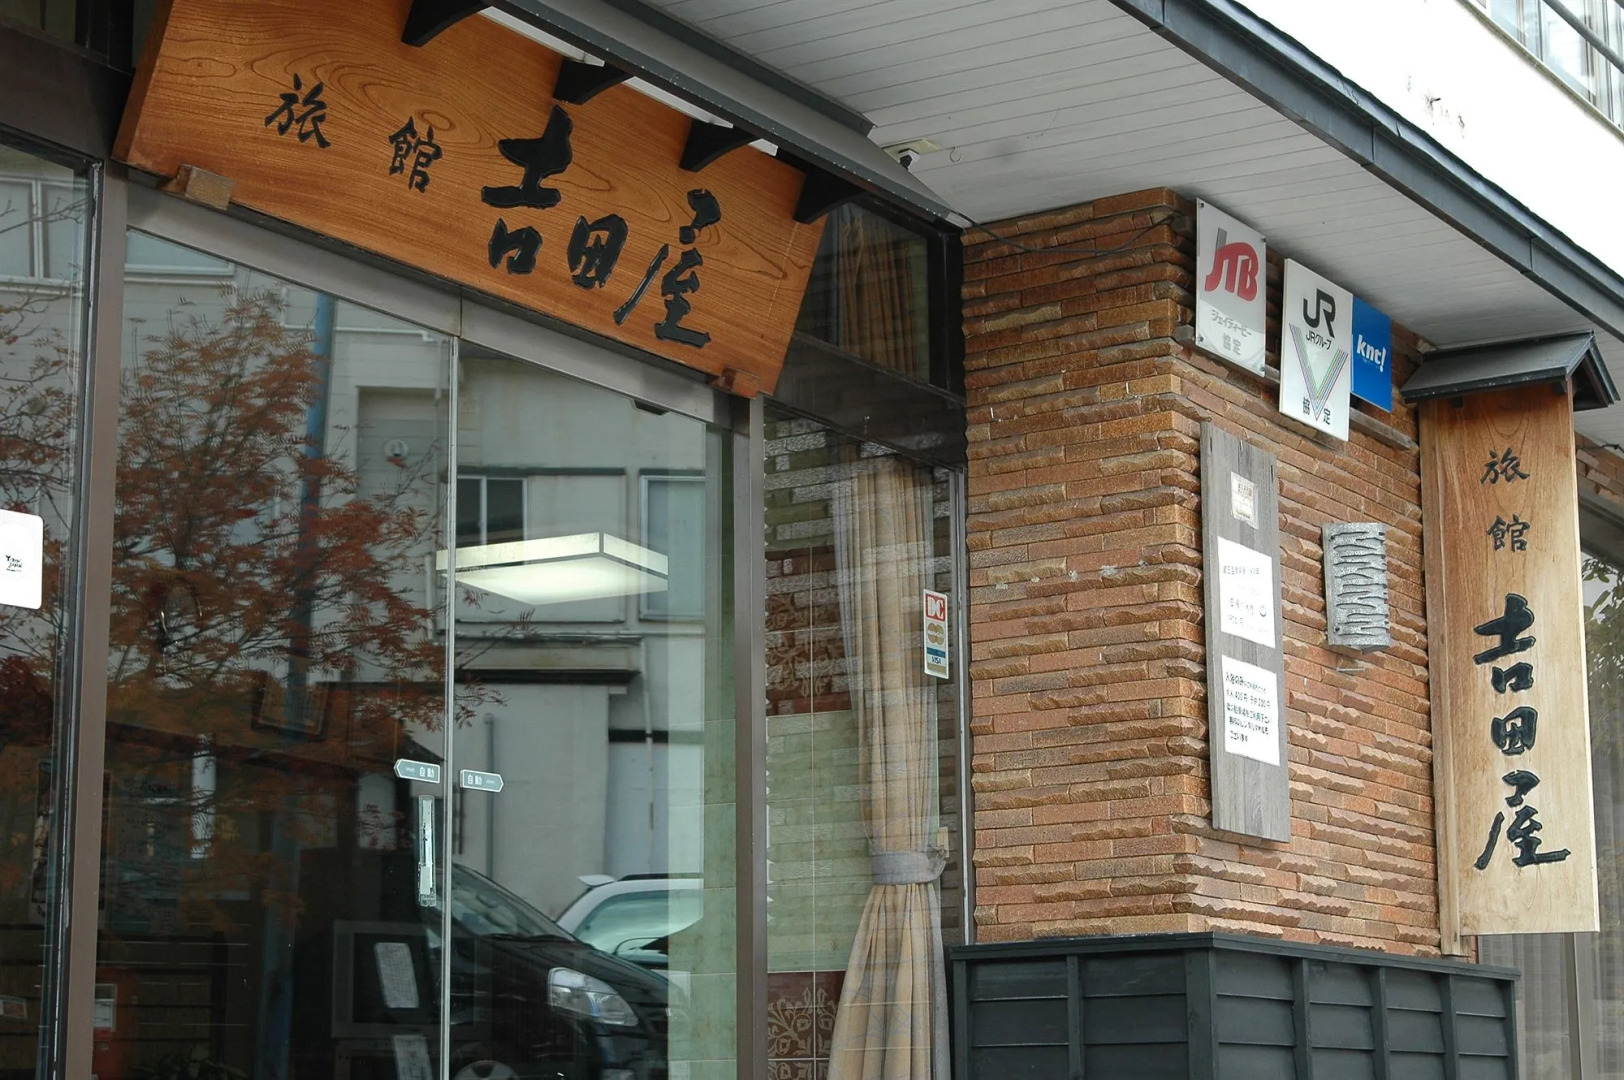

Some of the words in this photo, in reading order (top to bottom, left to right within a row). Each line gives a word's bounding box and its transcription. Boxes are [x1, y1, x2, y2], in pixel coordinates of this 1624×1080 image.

[264, 74, 442, 193] 旅館
[1205, 227, 1260, 302] JTB
[1303, 288, 1336, 338] JR
[1305, 330, 1332, 351] JRグループ
[1480, 447, 1530, 553] 旅館
[927, 596, 944, 620] DC
[419, 766, 434, 778] 自動
[468, 774, 482, 785] 自動
